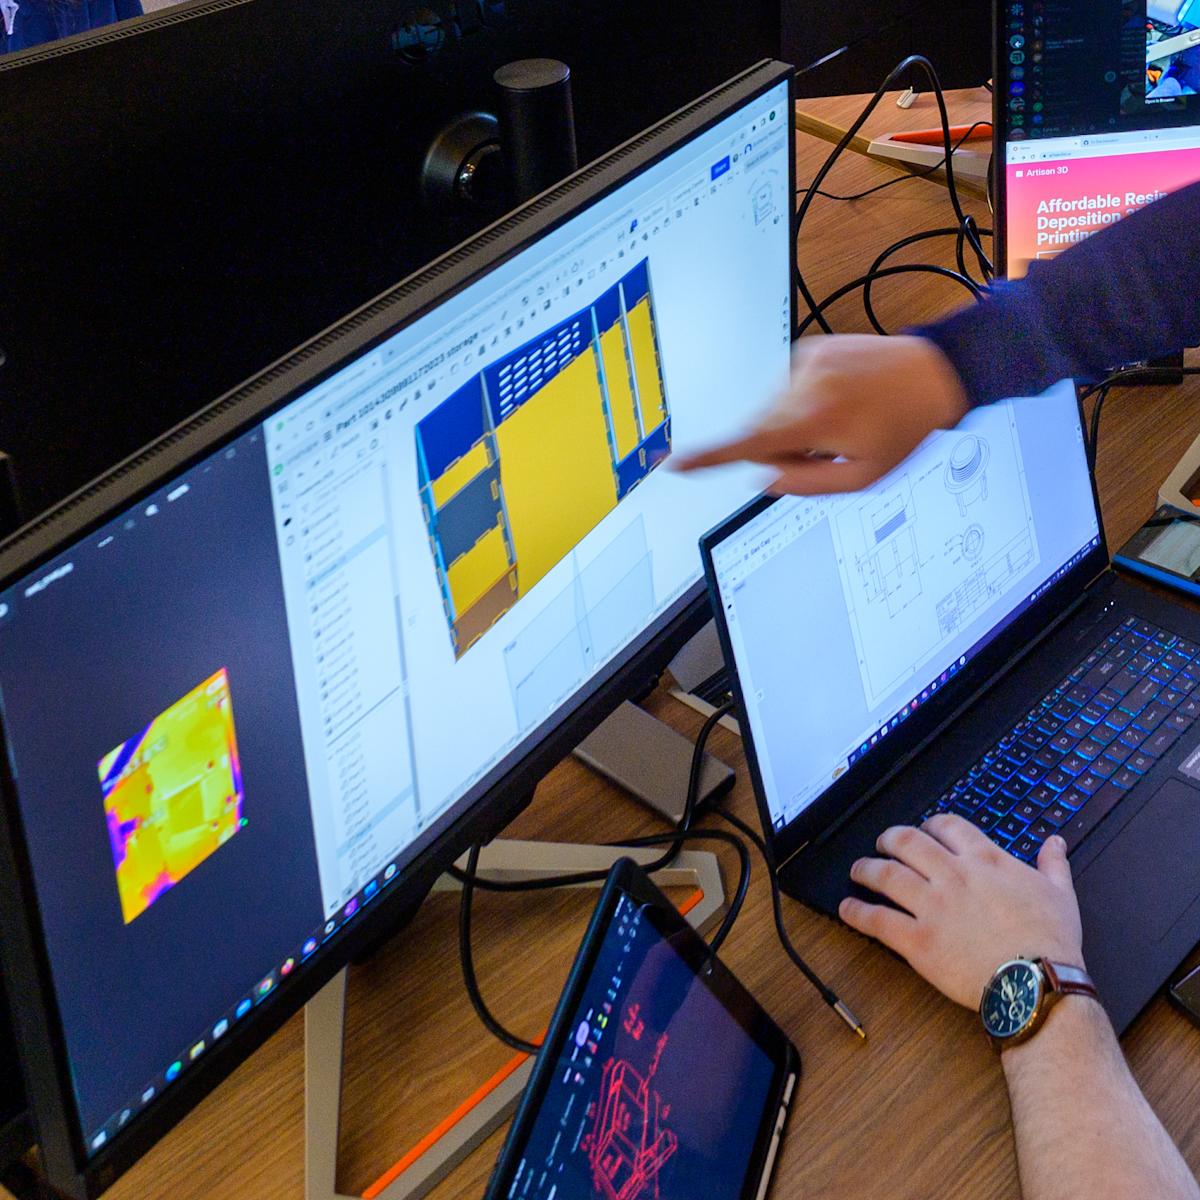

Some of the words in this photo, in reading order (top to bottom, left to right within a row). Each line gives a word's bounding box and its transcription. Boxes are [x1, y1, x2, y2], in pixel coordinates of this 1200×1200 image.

[1026, 167, 1055, 177] Artisan
[1057, 166, 1069, 175] 3D
[1037, 193, 1121, 214] Affordable
[1037, 210, 1121, 230] Deposition
[1037, 228, 1100, 246] Printin
